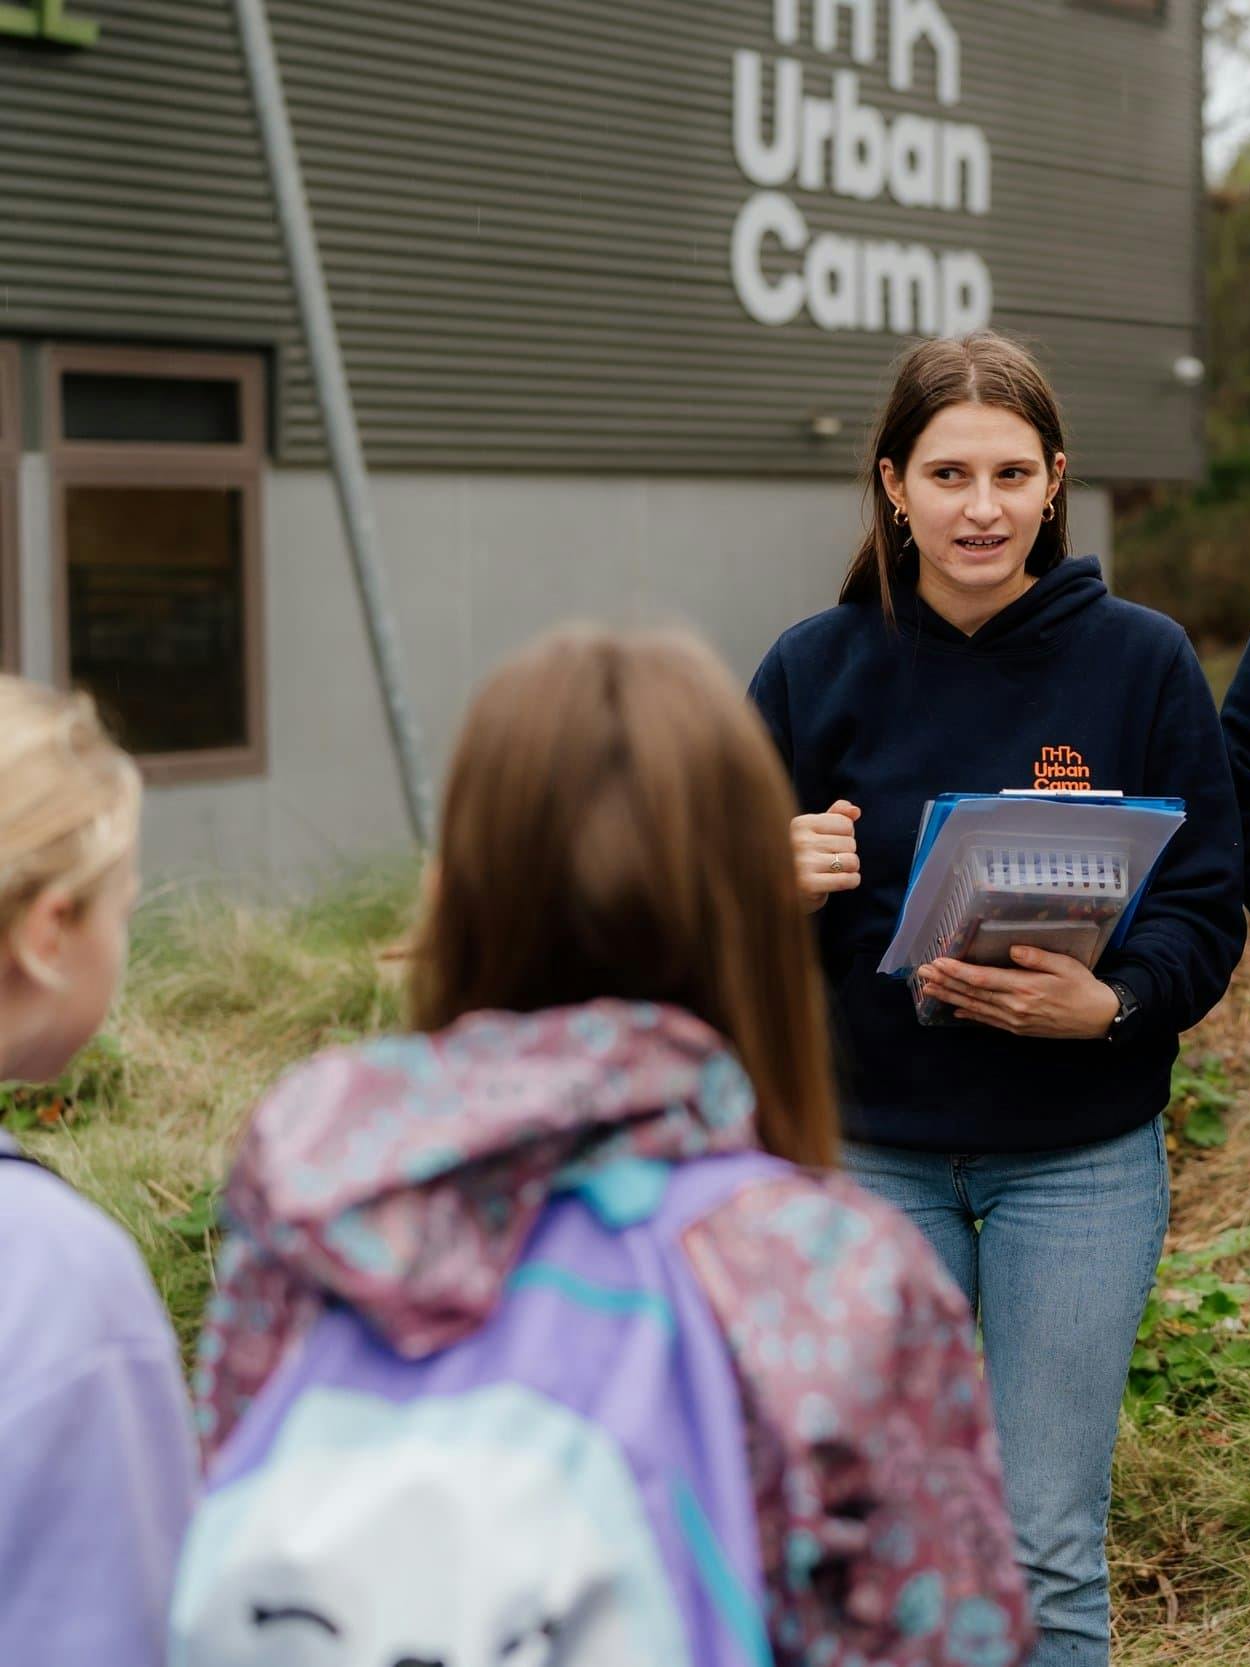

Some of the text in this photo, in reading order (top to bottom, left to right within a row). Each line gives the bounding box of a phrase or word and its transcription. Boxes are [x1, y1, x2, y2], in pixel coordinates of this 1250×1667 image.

[733, 49, 992, 215] Urban
[731, 190, 993, 338] Camp
[1034, 761, 1090, 778] Urban
